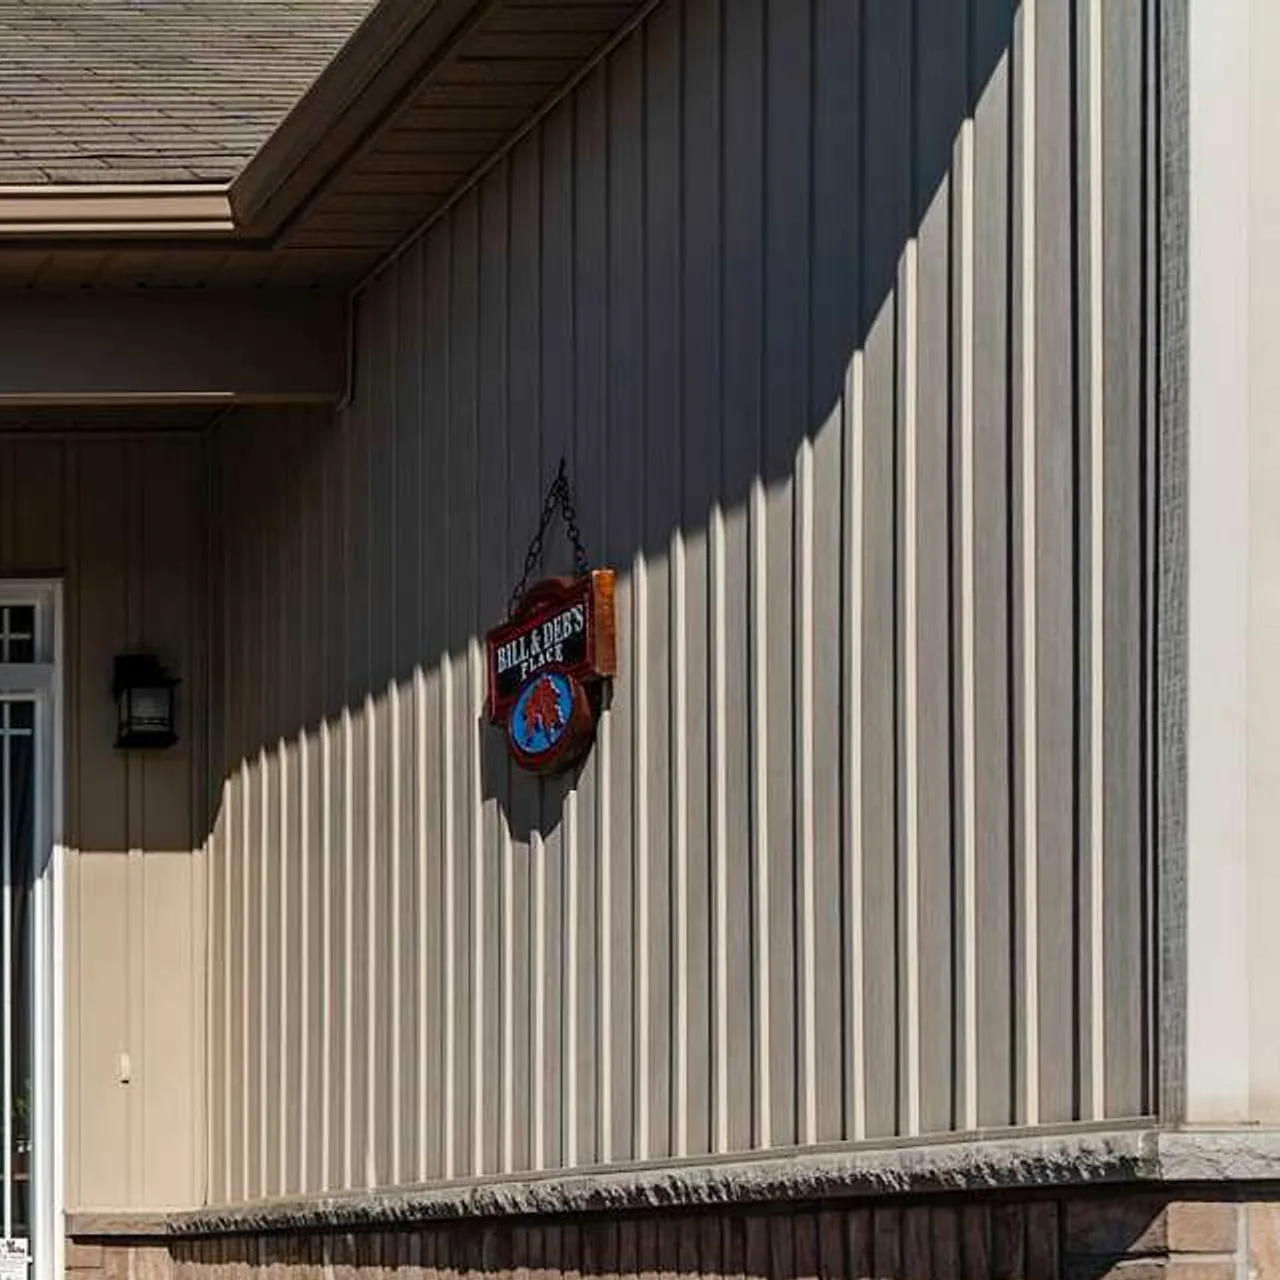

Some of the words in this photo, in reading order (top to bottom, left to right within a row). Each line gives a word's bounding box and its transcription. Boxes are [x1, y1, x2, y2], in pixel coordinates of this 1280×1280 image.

[497, 636, 530, 673] BILL
[530, 629, 541, 656] &
[542, 604, 584, 649] DEB'S
[520, 643, 564, 681] PLACE
